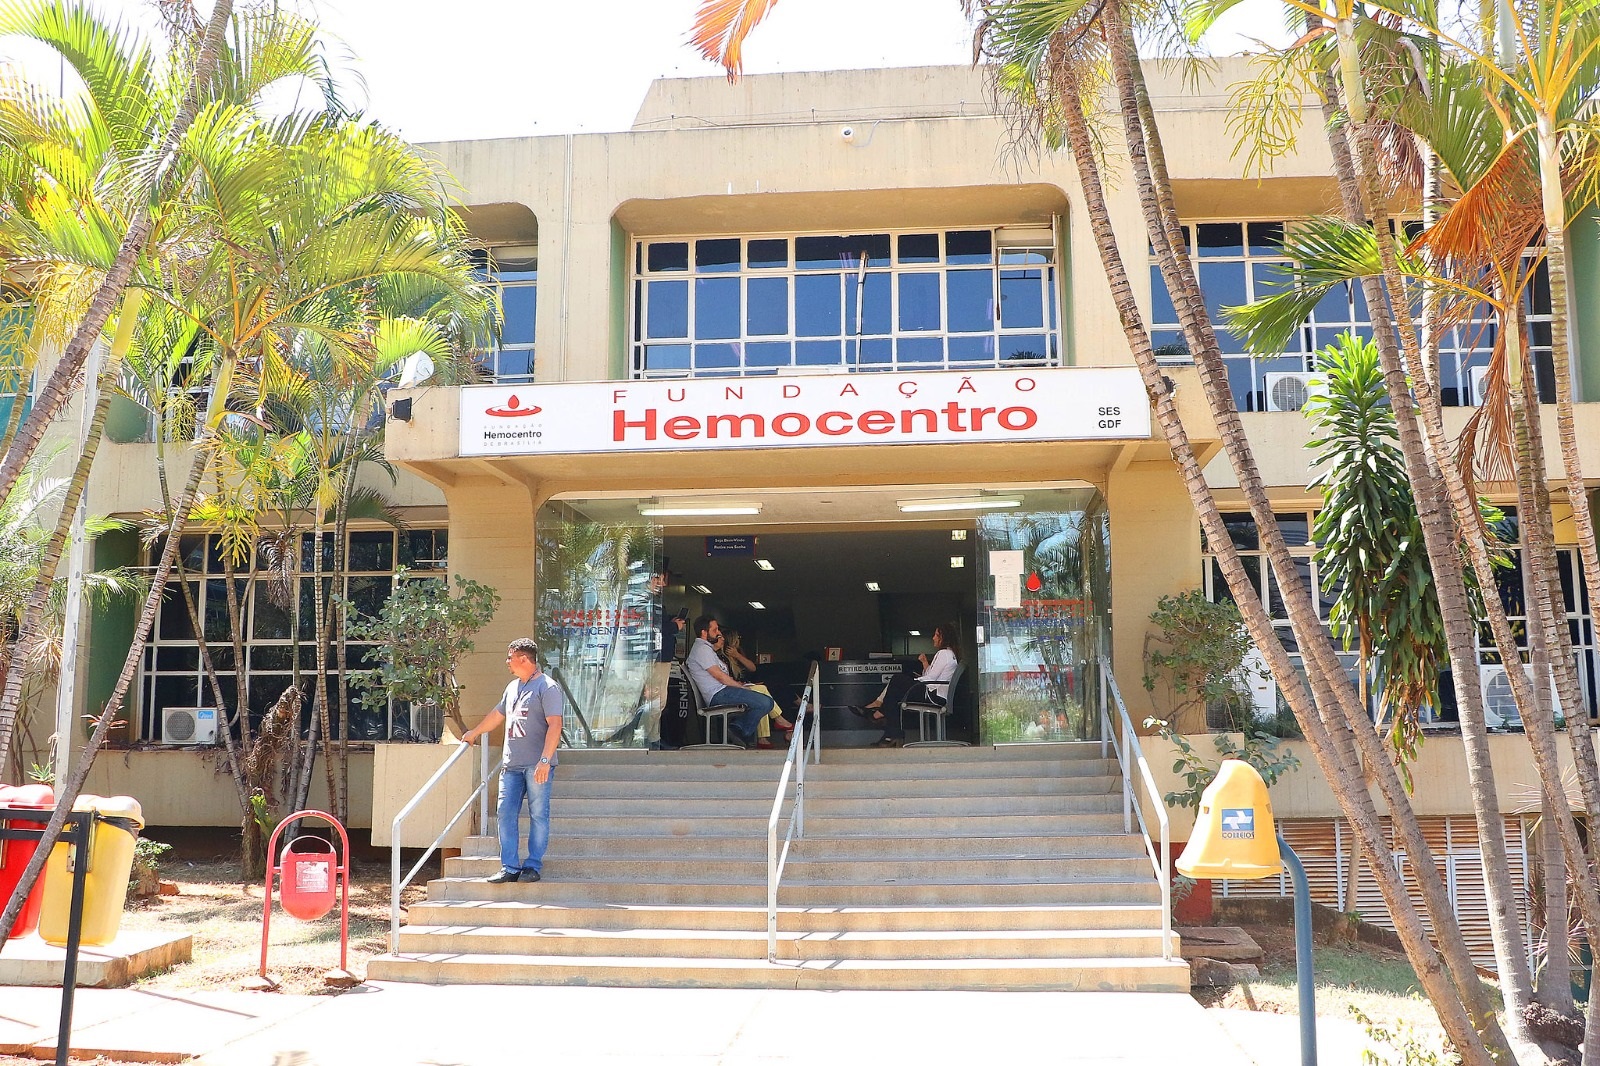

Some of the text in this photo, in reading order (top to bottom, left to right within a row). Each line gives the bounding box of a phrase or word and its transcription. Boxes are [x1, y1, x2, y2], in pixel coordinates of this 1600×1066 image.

[613, 376, 1036, 404] FUNDAÇÃO
[1098, 406, 1120, 416] SES
[613, 401, 1038, 442] Hemocentro
[1098, 419, 1121, 429] GDF
[484, 430, 542, 439] Hemocentro
[679, 673, 688, 718] SENHA
